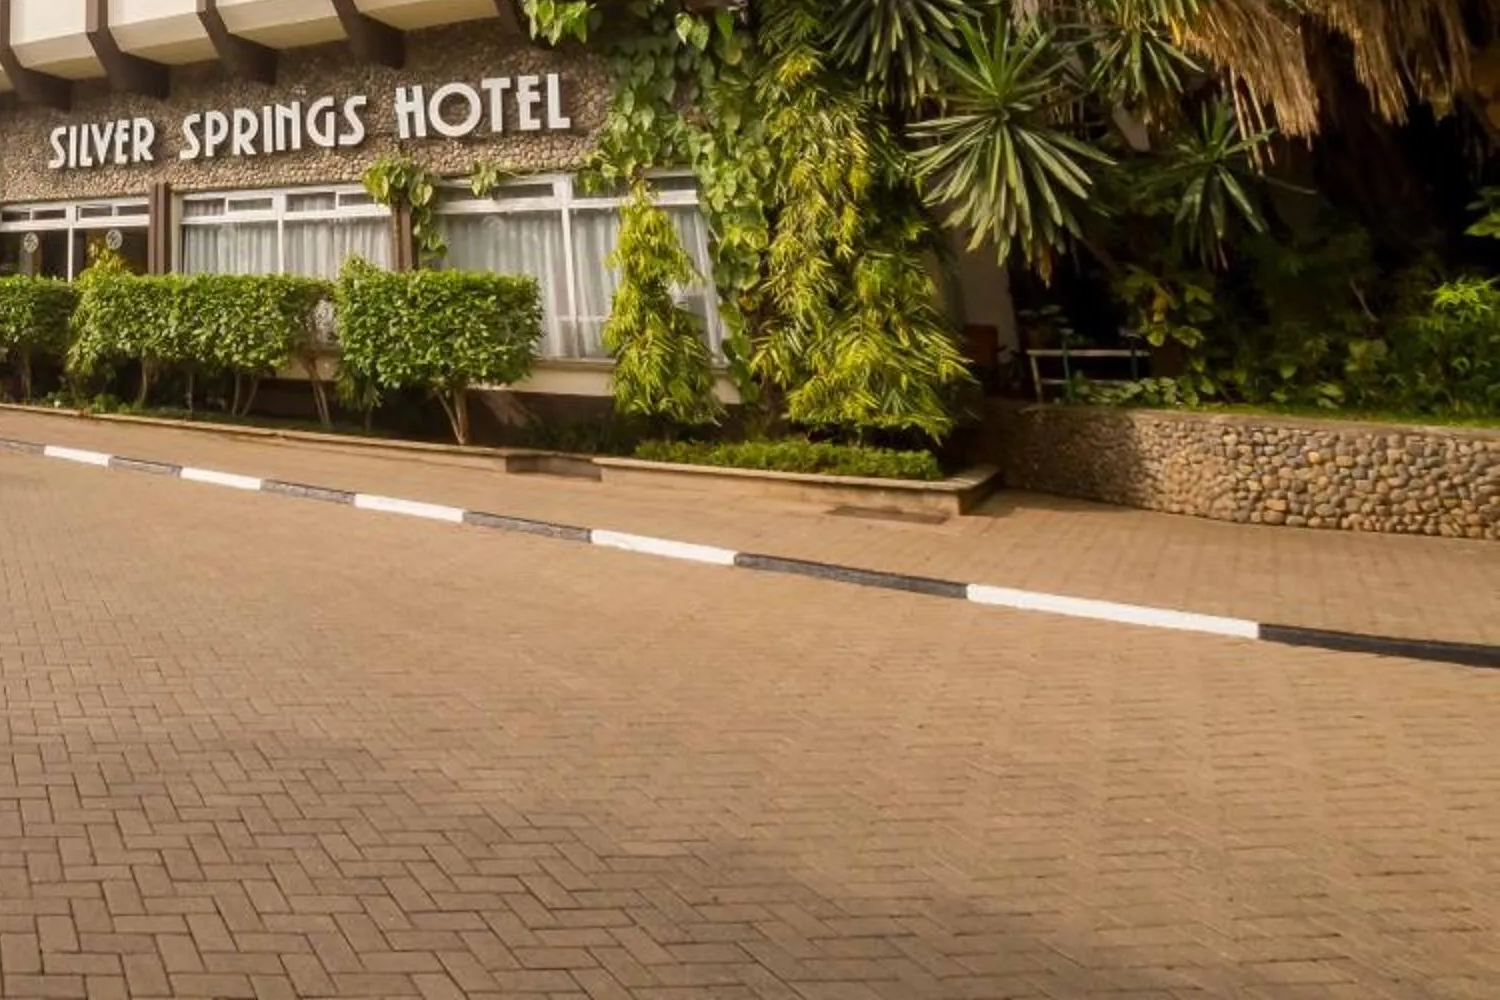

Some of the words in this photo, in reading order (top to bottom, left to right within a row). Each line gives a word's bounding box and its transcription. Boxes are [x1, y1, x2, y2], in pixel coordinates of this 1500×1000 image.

[47, 117, 155, 169] SILVER
[179, 95, 367, 161] SPRINGS
[394, 73, 571, 139] HOTEL
